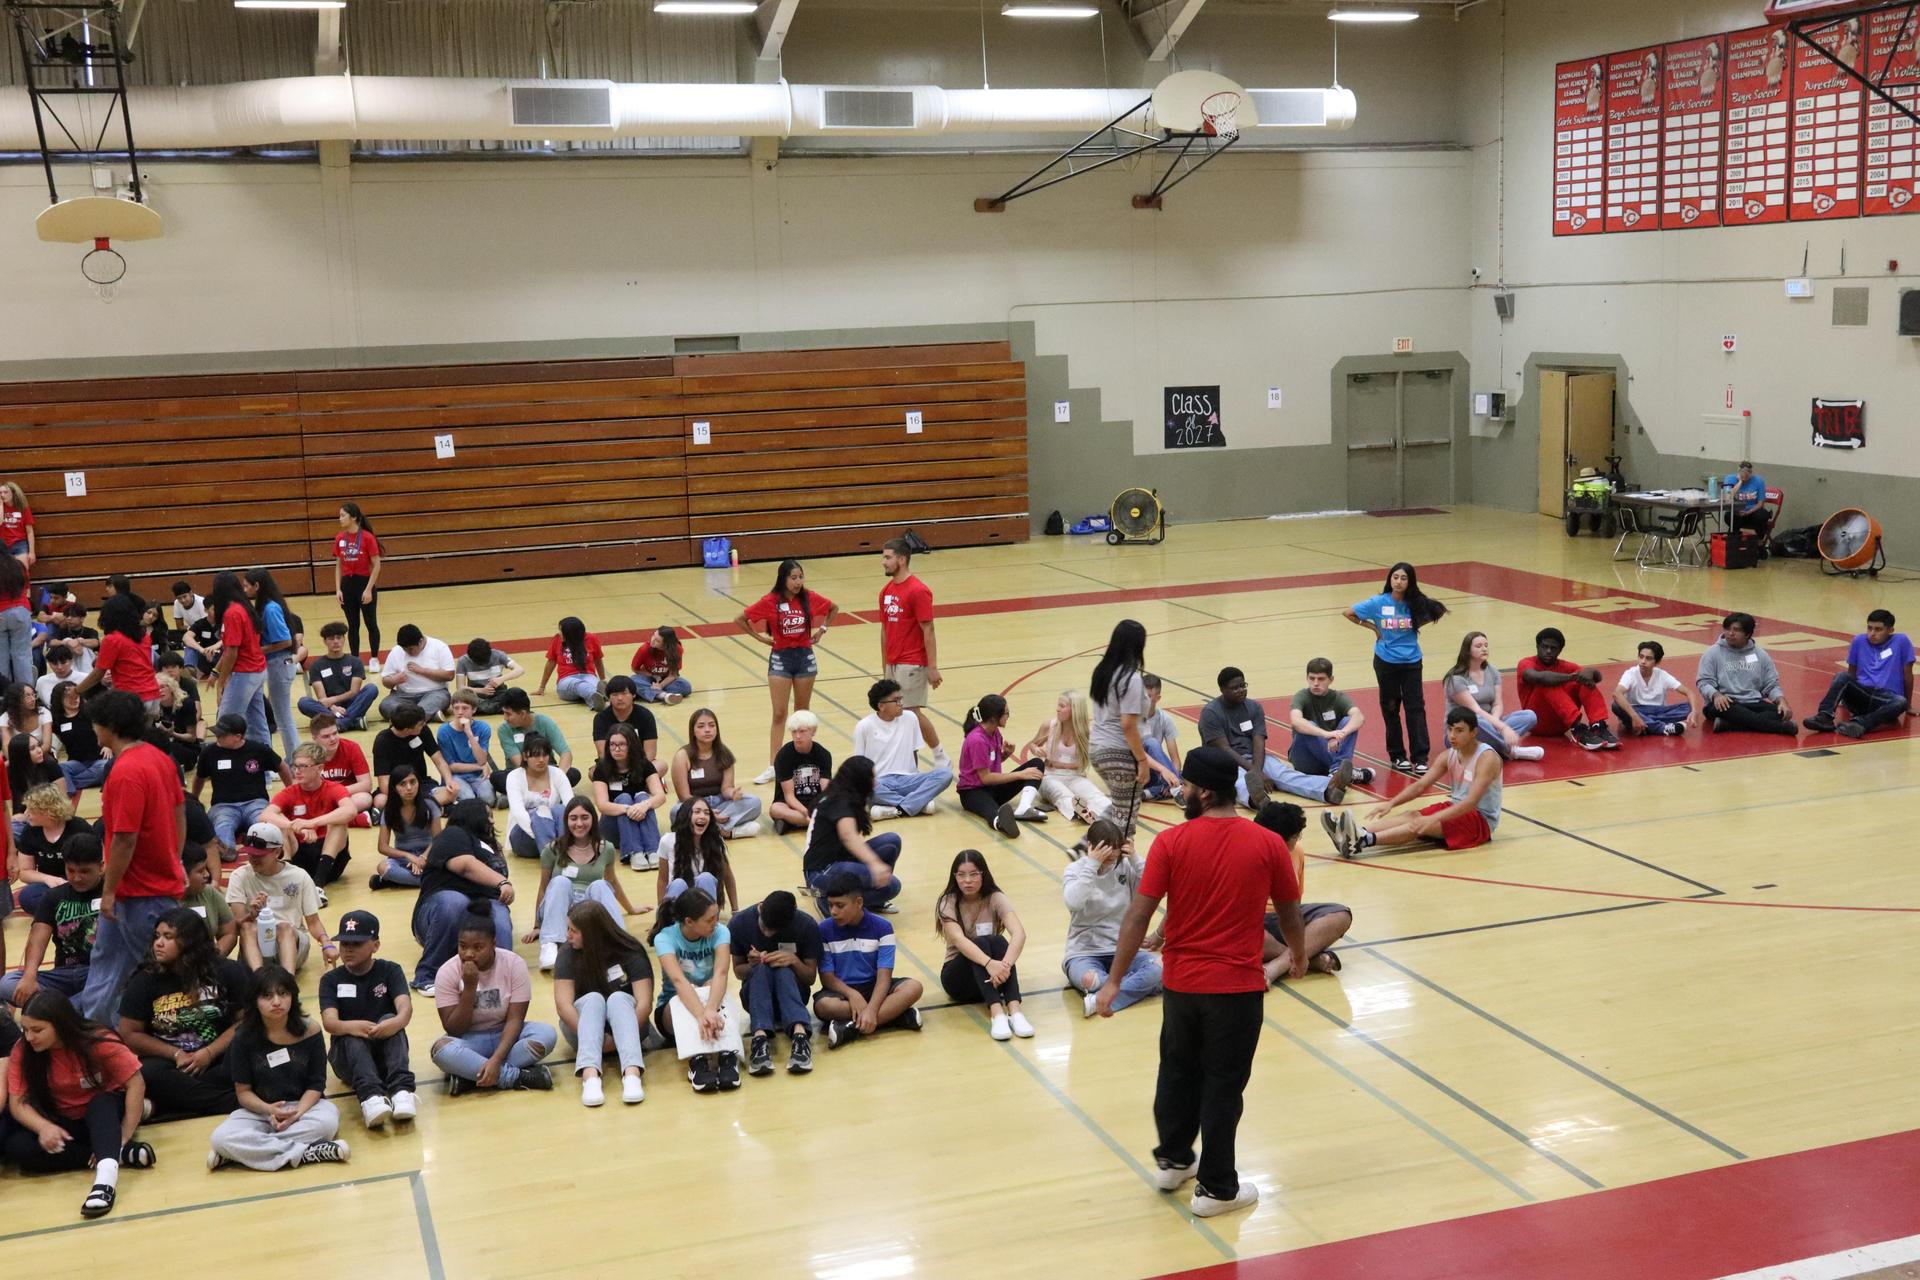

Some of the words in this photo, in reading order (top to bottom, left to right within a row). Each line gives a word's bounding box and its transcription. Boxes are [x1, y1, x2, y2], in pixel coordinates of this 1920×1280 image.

[1872, 25, 1889, 35] HIGH
[1730, 52, 1744, 60] HIGH
[1805, 78, 1848, 90] Wrestling
[1732, 92, 1751, 103] Boys
[1754, 88, 1780, 100] Soccer
[1871, 122, 1885, 130] 2001
[1896, 120, 1910, 128] 2011
[1871, 138, 1885, 146] 2002
[1870, 171, 1885, 179] 2004
[1397, 339, 1410, 350] EXIT
[1058, 406, 1067, 414] 17
[910, 416, 919, 424] 16
[1185, 414, 1196, 428] of
[697, 427, 707, 435] 15
[1175, 425, 1214, 446] 2027
[440, 440, 450, 448] 14
[70, 477, 82, 486] 13
[783, 617, 805, 627] ASB
